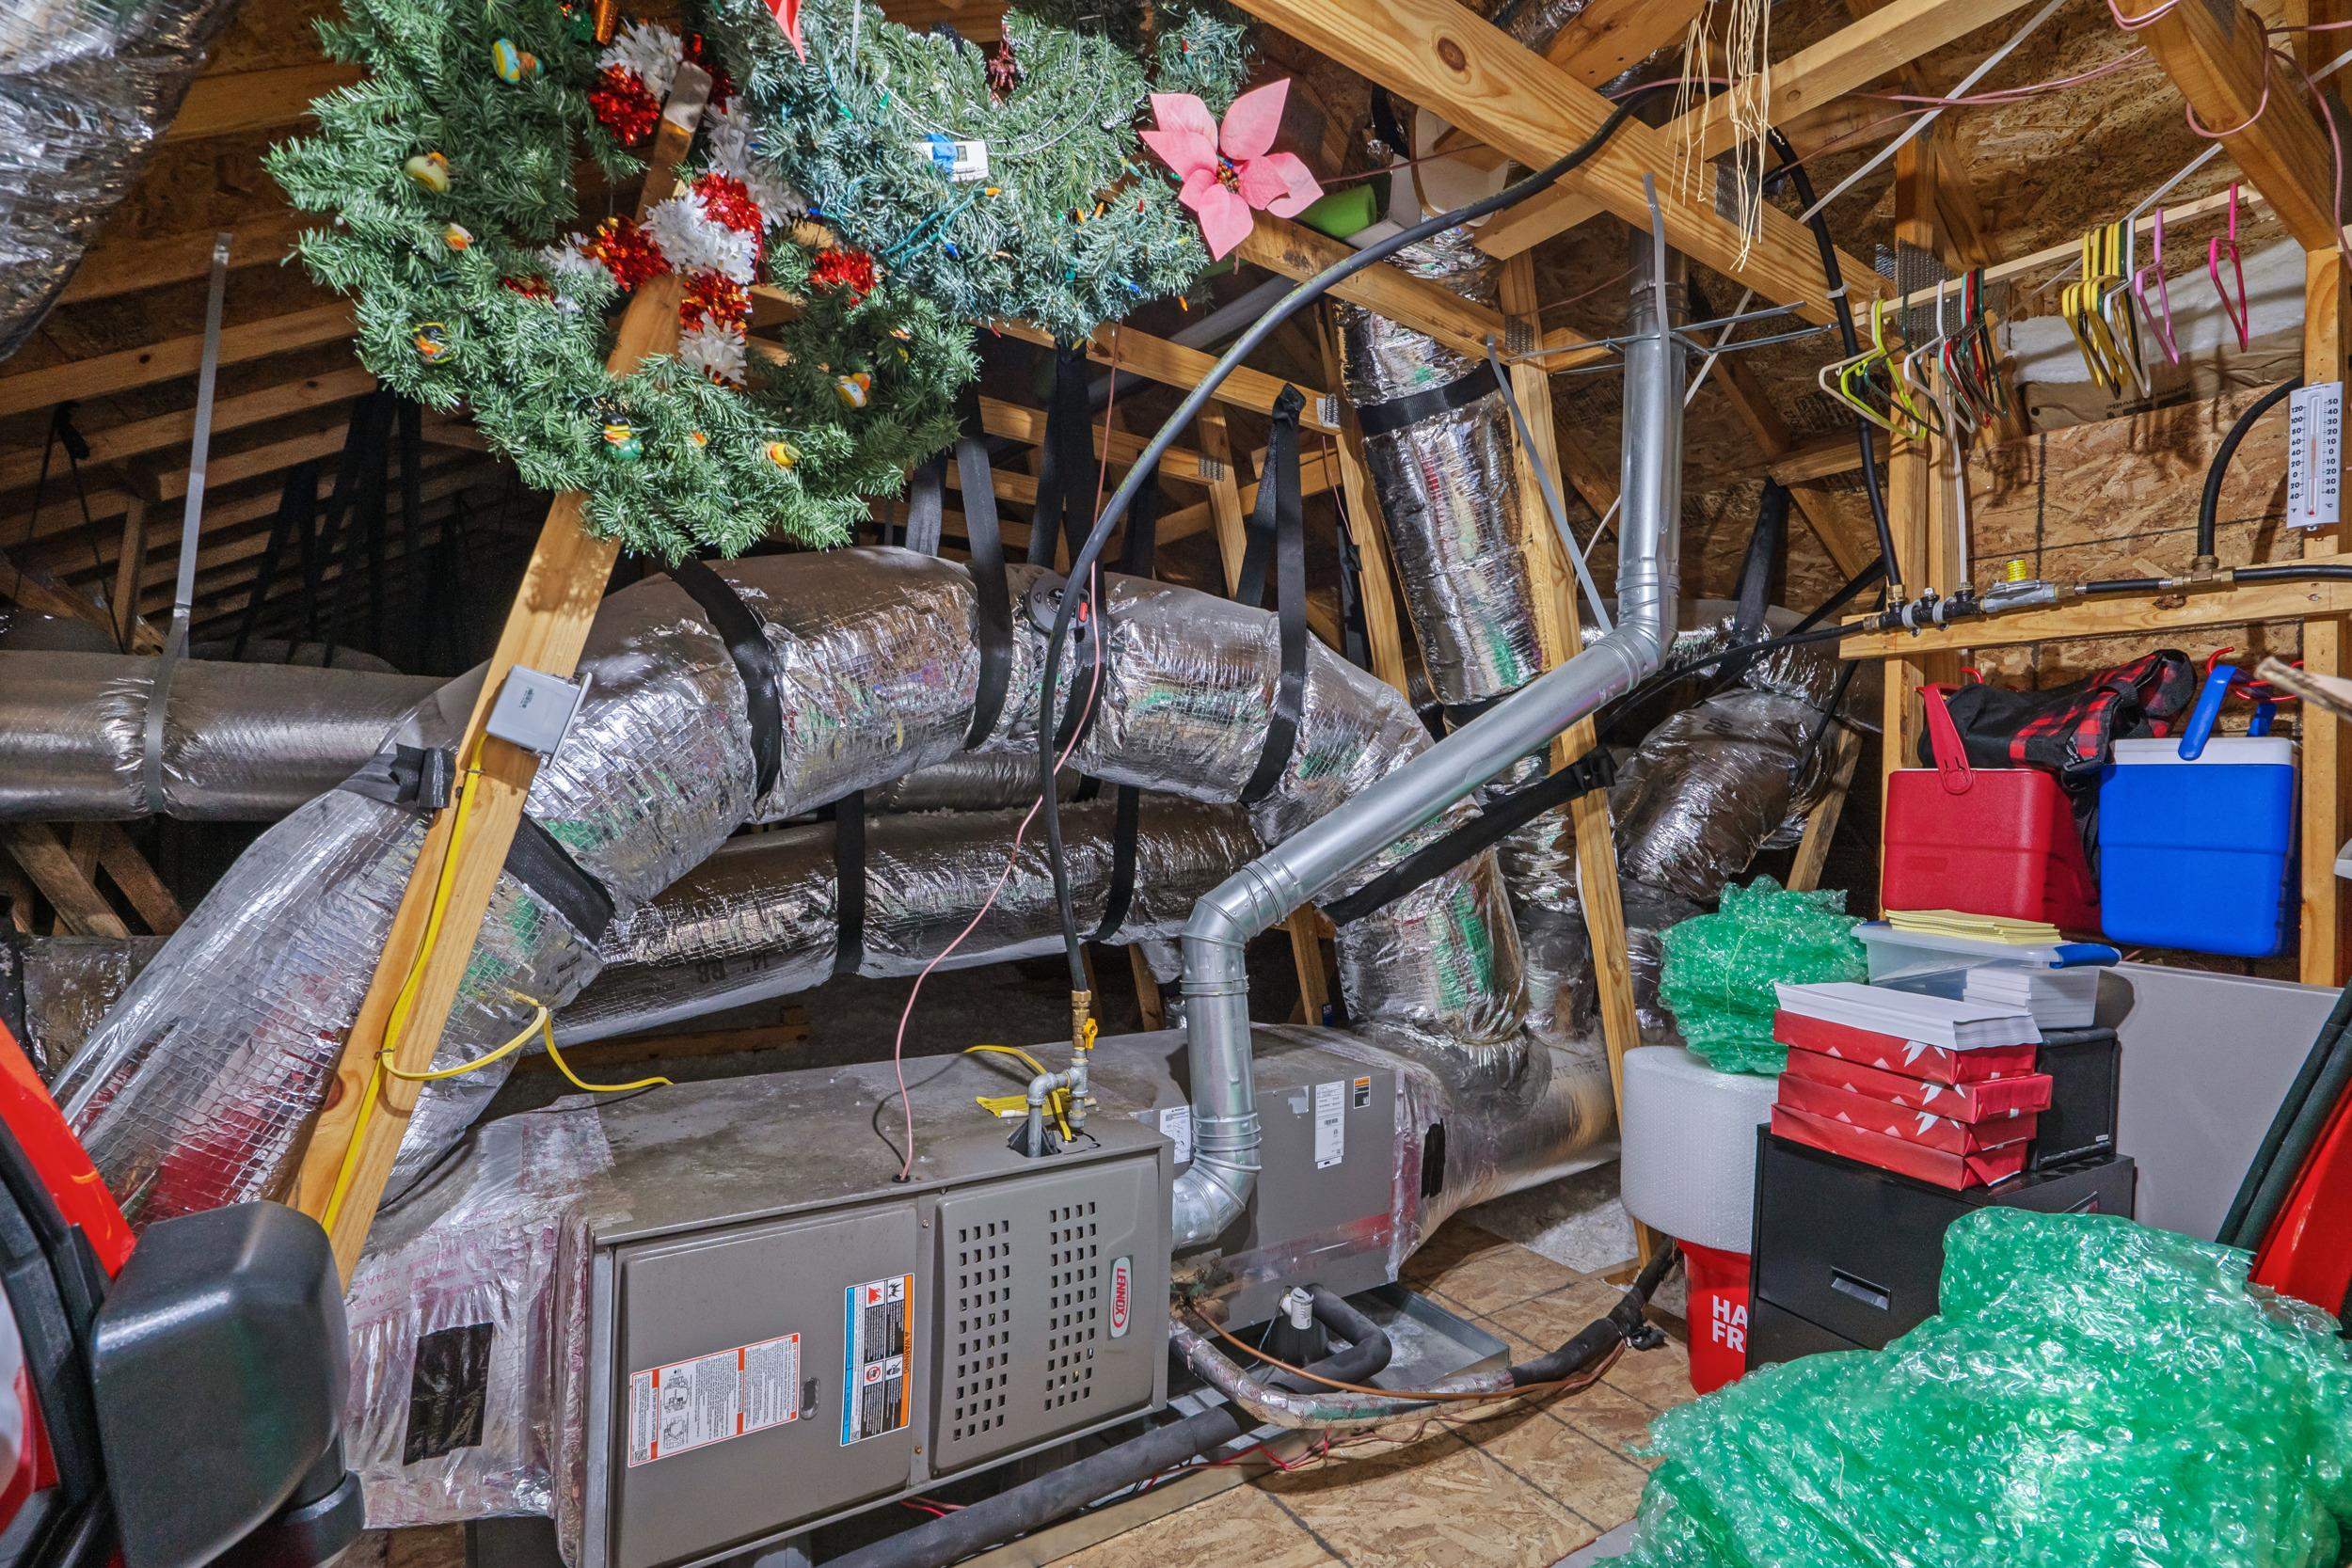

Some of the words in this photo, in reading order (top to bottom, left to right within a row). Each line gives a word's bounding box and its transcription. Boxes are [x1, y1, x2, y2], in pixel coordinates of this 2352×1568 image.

[2291, 416, 2303, 424] 100
[2291, 459, 2300, 467] 20
[1116, 1268, 1126, 1315] LENNOX
[1712, 1319, 1745, 1354] FR
